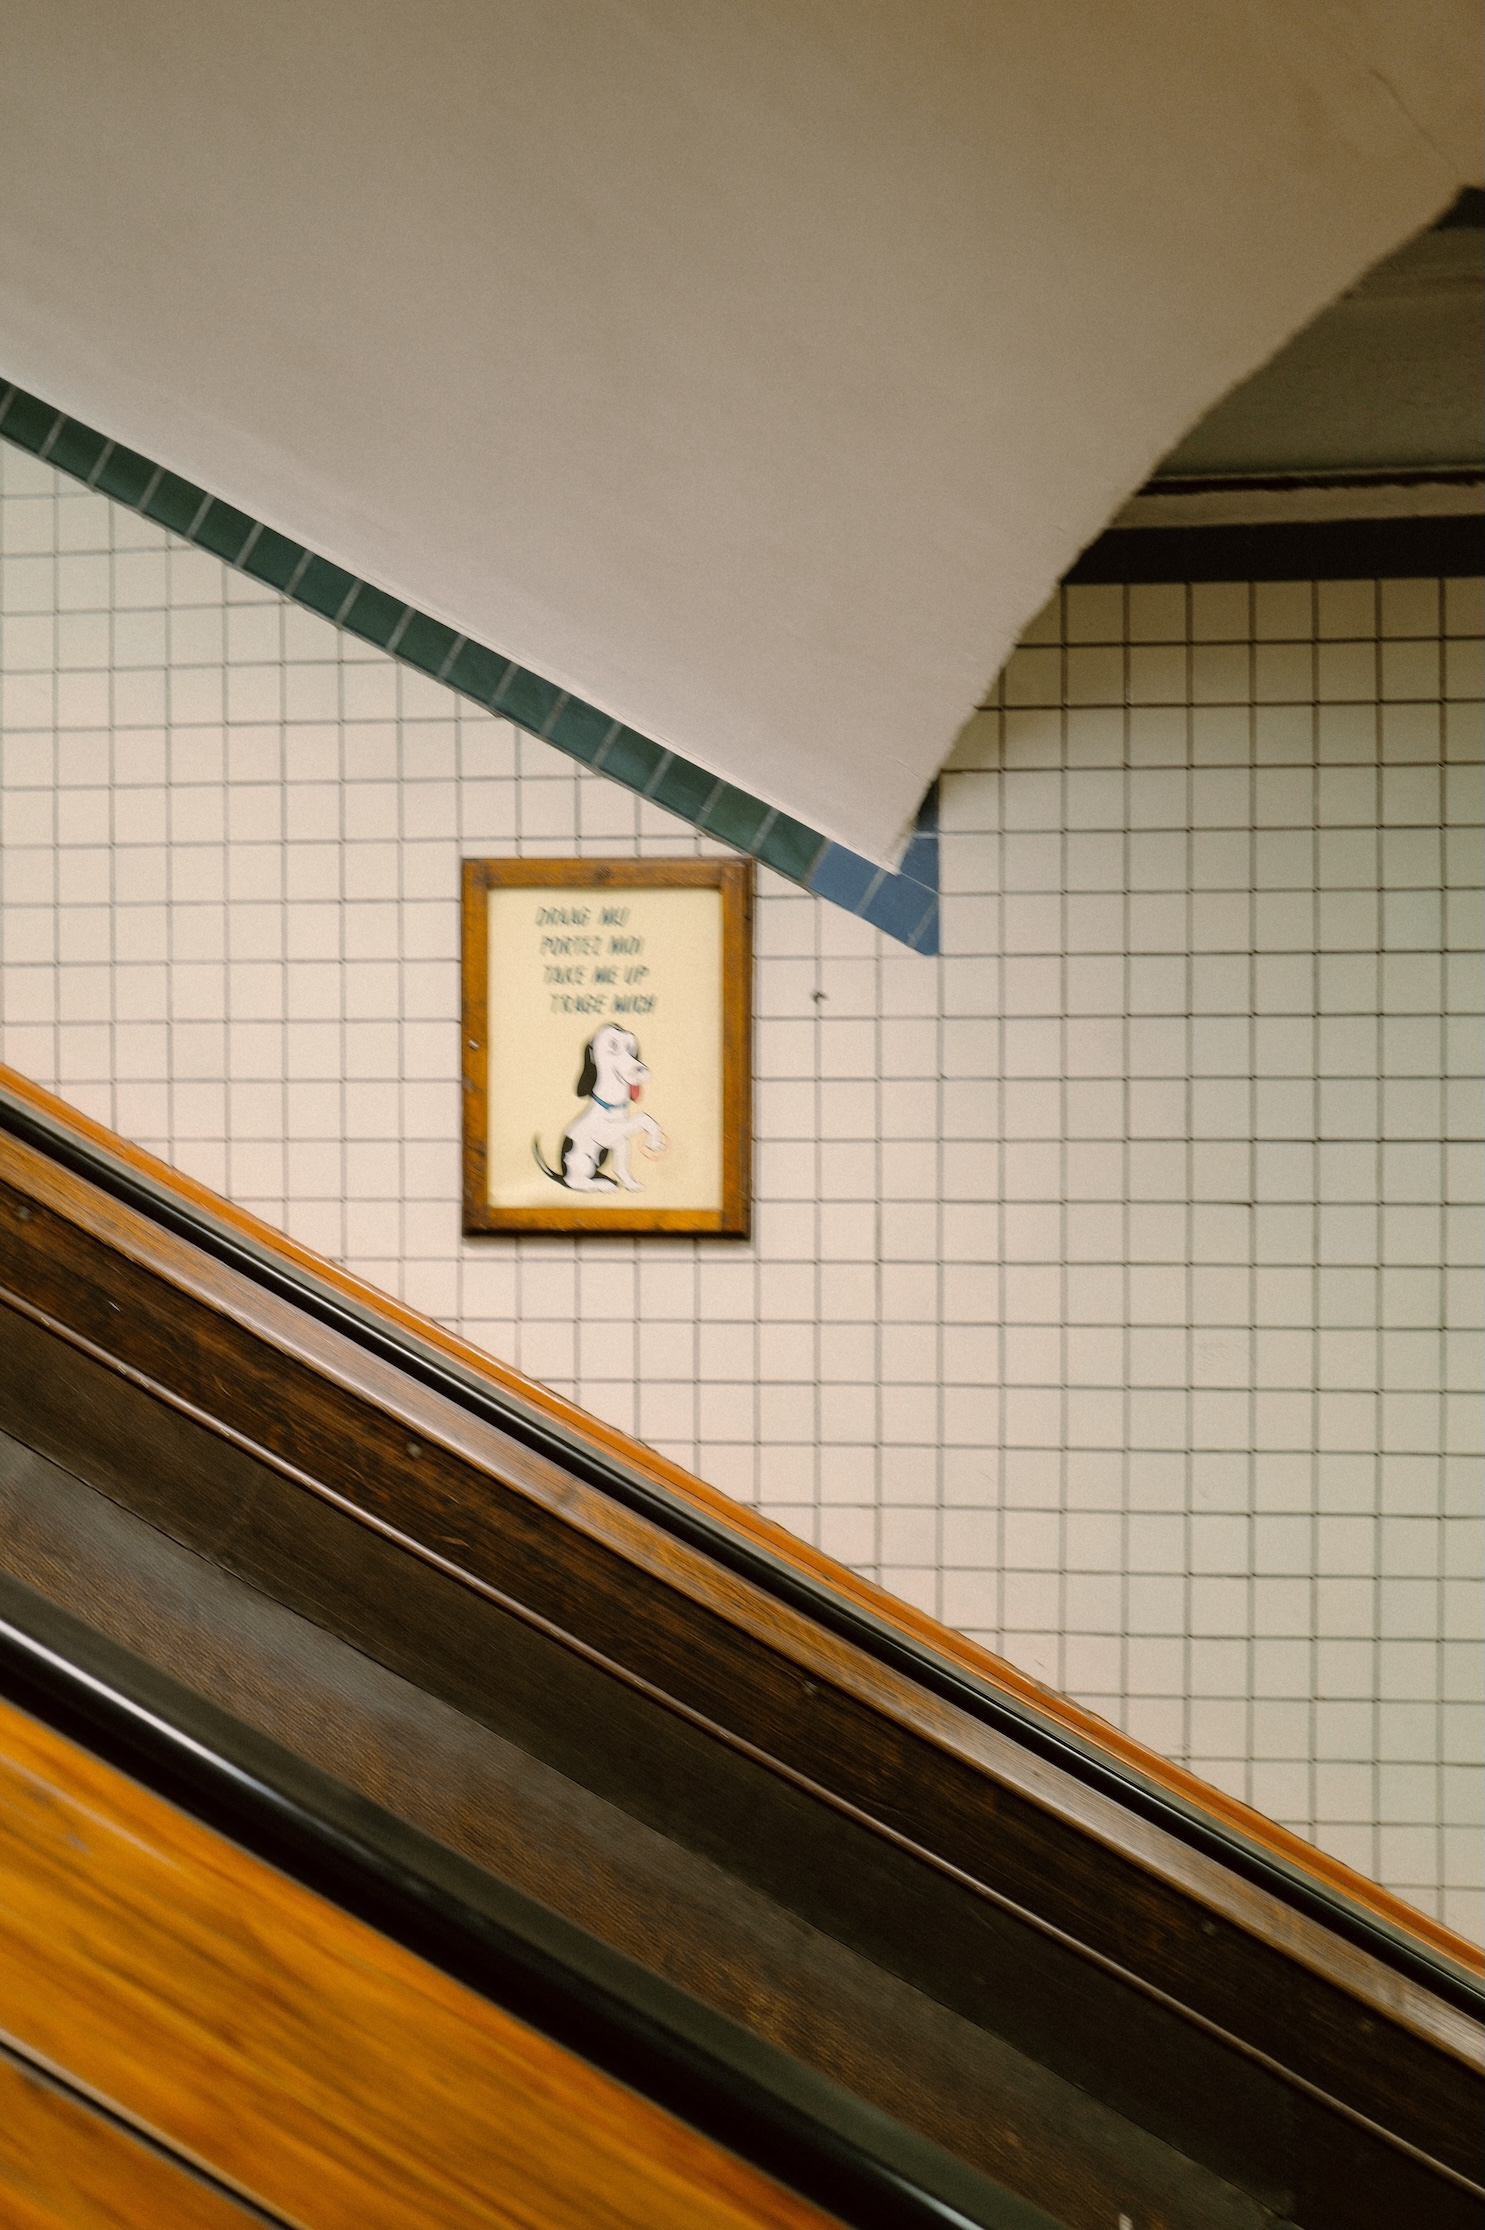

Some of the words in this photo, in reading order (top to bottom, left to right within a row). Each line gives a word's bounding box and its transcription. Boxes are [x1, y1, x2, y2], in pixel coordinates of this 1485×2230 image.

[540, 936, 602, 955] PORTEZ
[544, 966, 586, 985] TAKE
[593, 966, 620, 985] ME
[624, 966, 650, 985] UP
